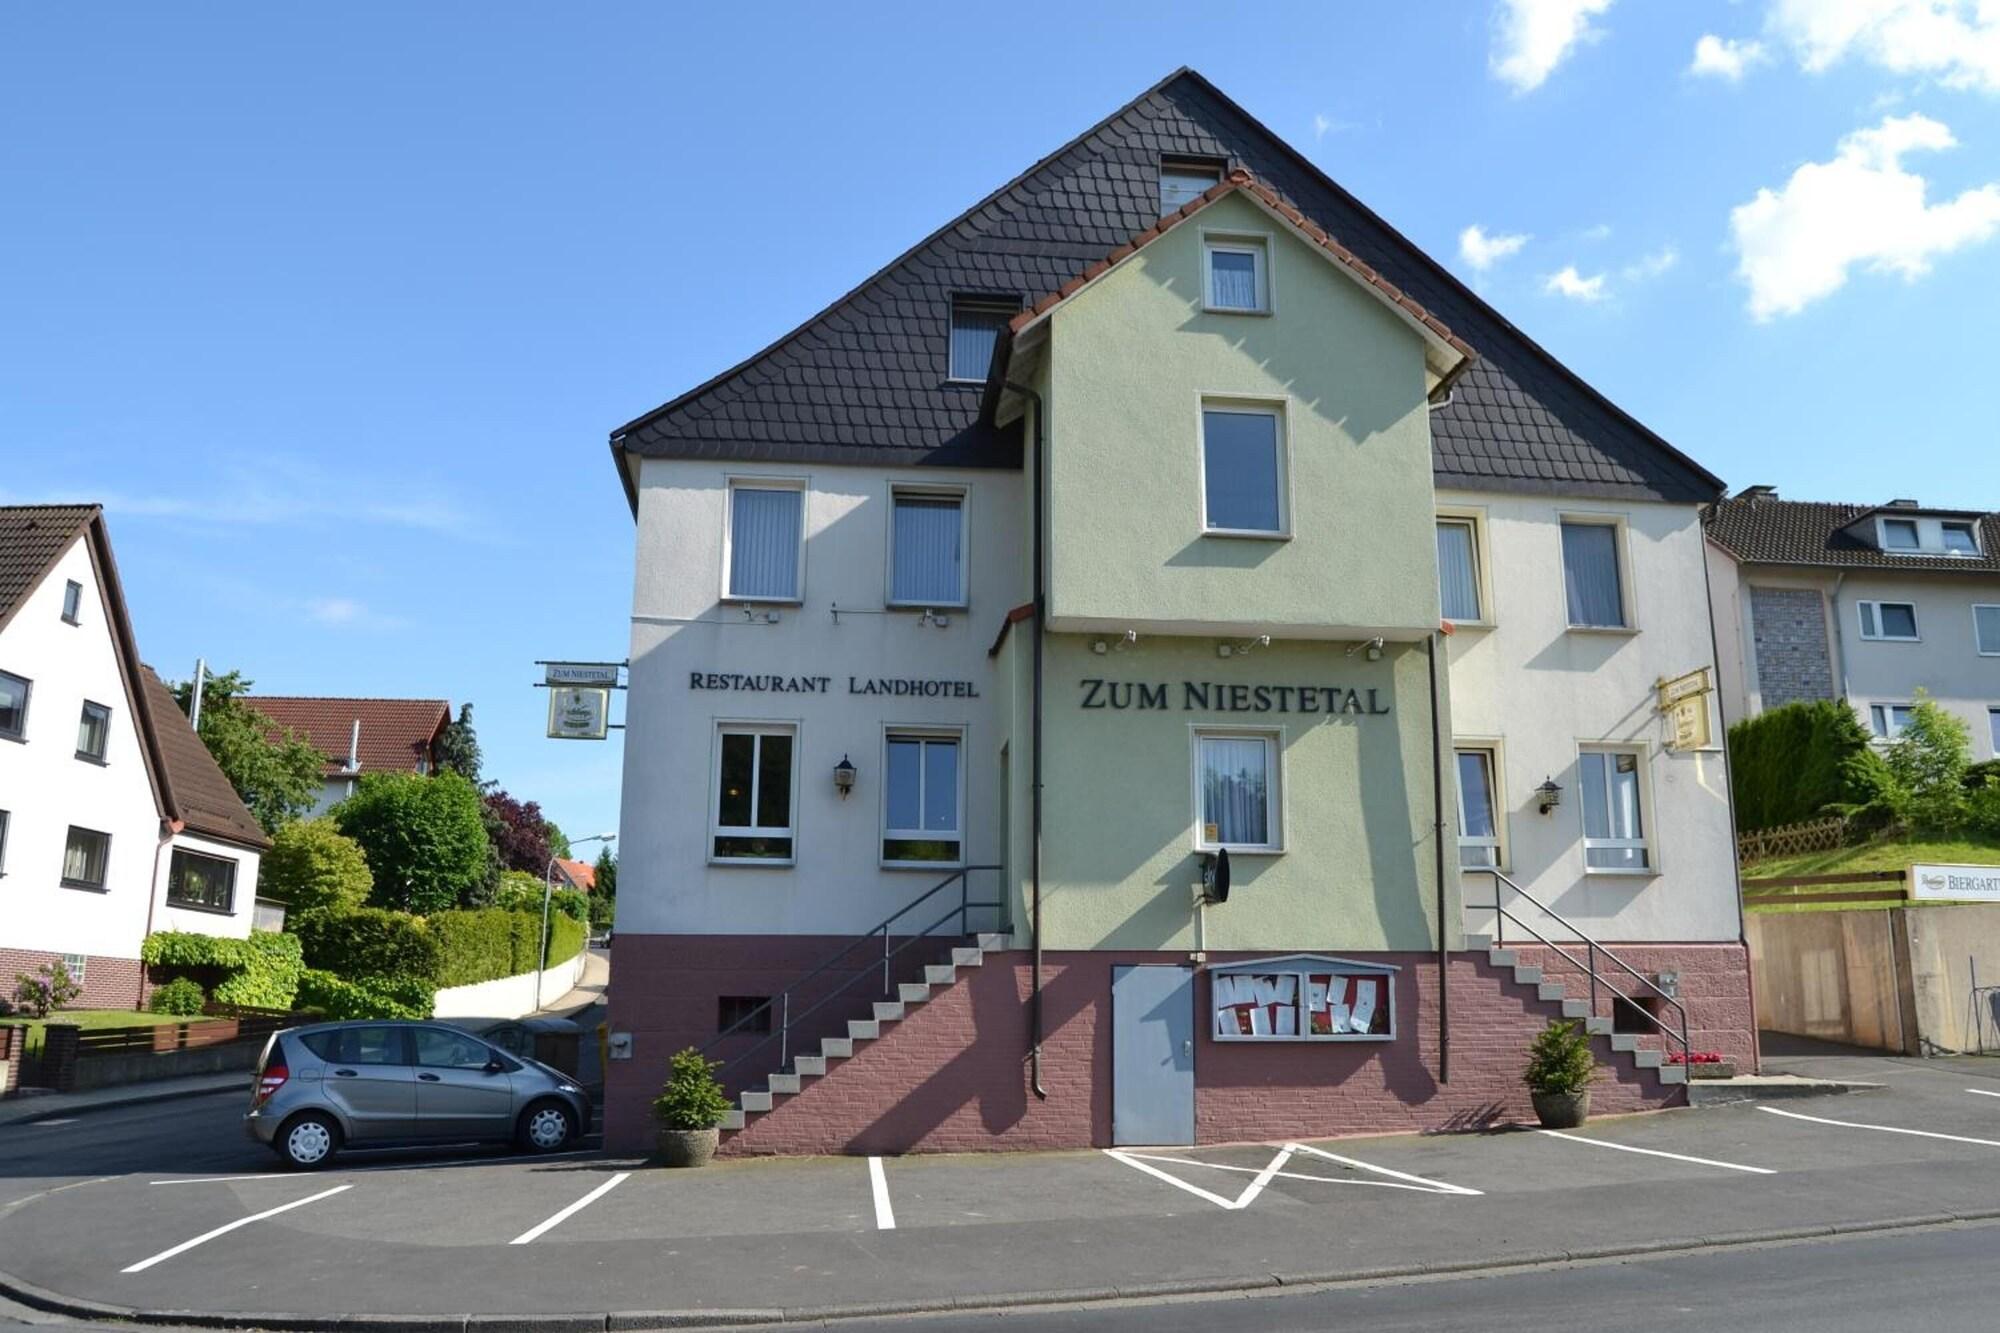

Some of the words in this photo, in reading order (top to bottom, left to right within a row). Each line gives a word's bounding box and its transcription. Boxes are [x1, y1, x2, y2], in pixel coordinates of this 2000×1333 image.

[690, 672, 831, 693] RESTAURANT
[849, 676, 980, 698] LANDHOTEL
[1080, 679, 1168, 710] ZUM
[1183, 681, 1390, 715] NIESTETAL
[1948, 875, 2000, 891] BIERGART
